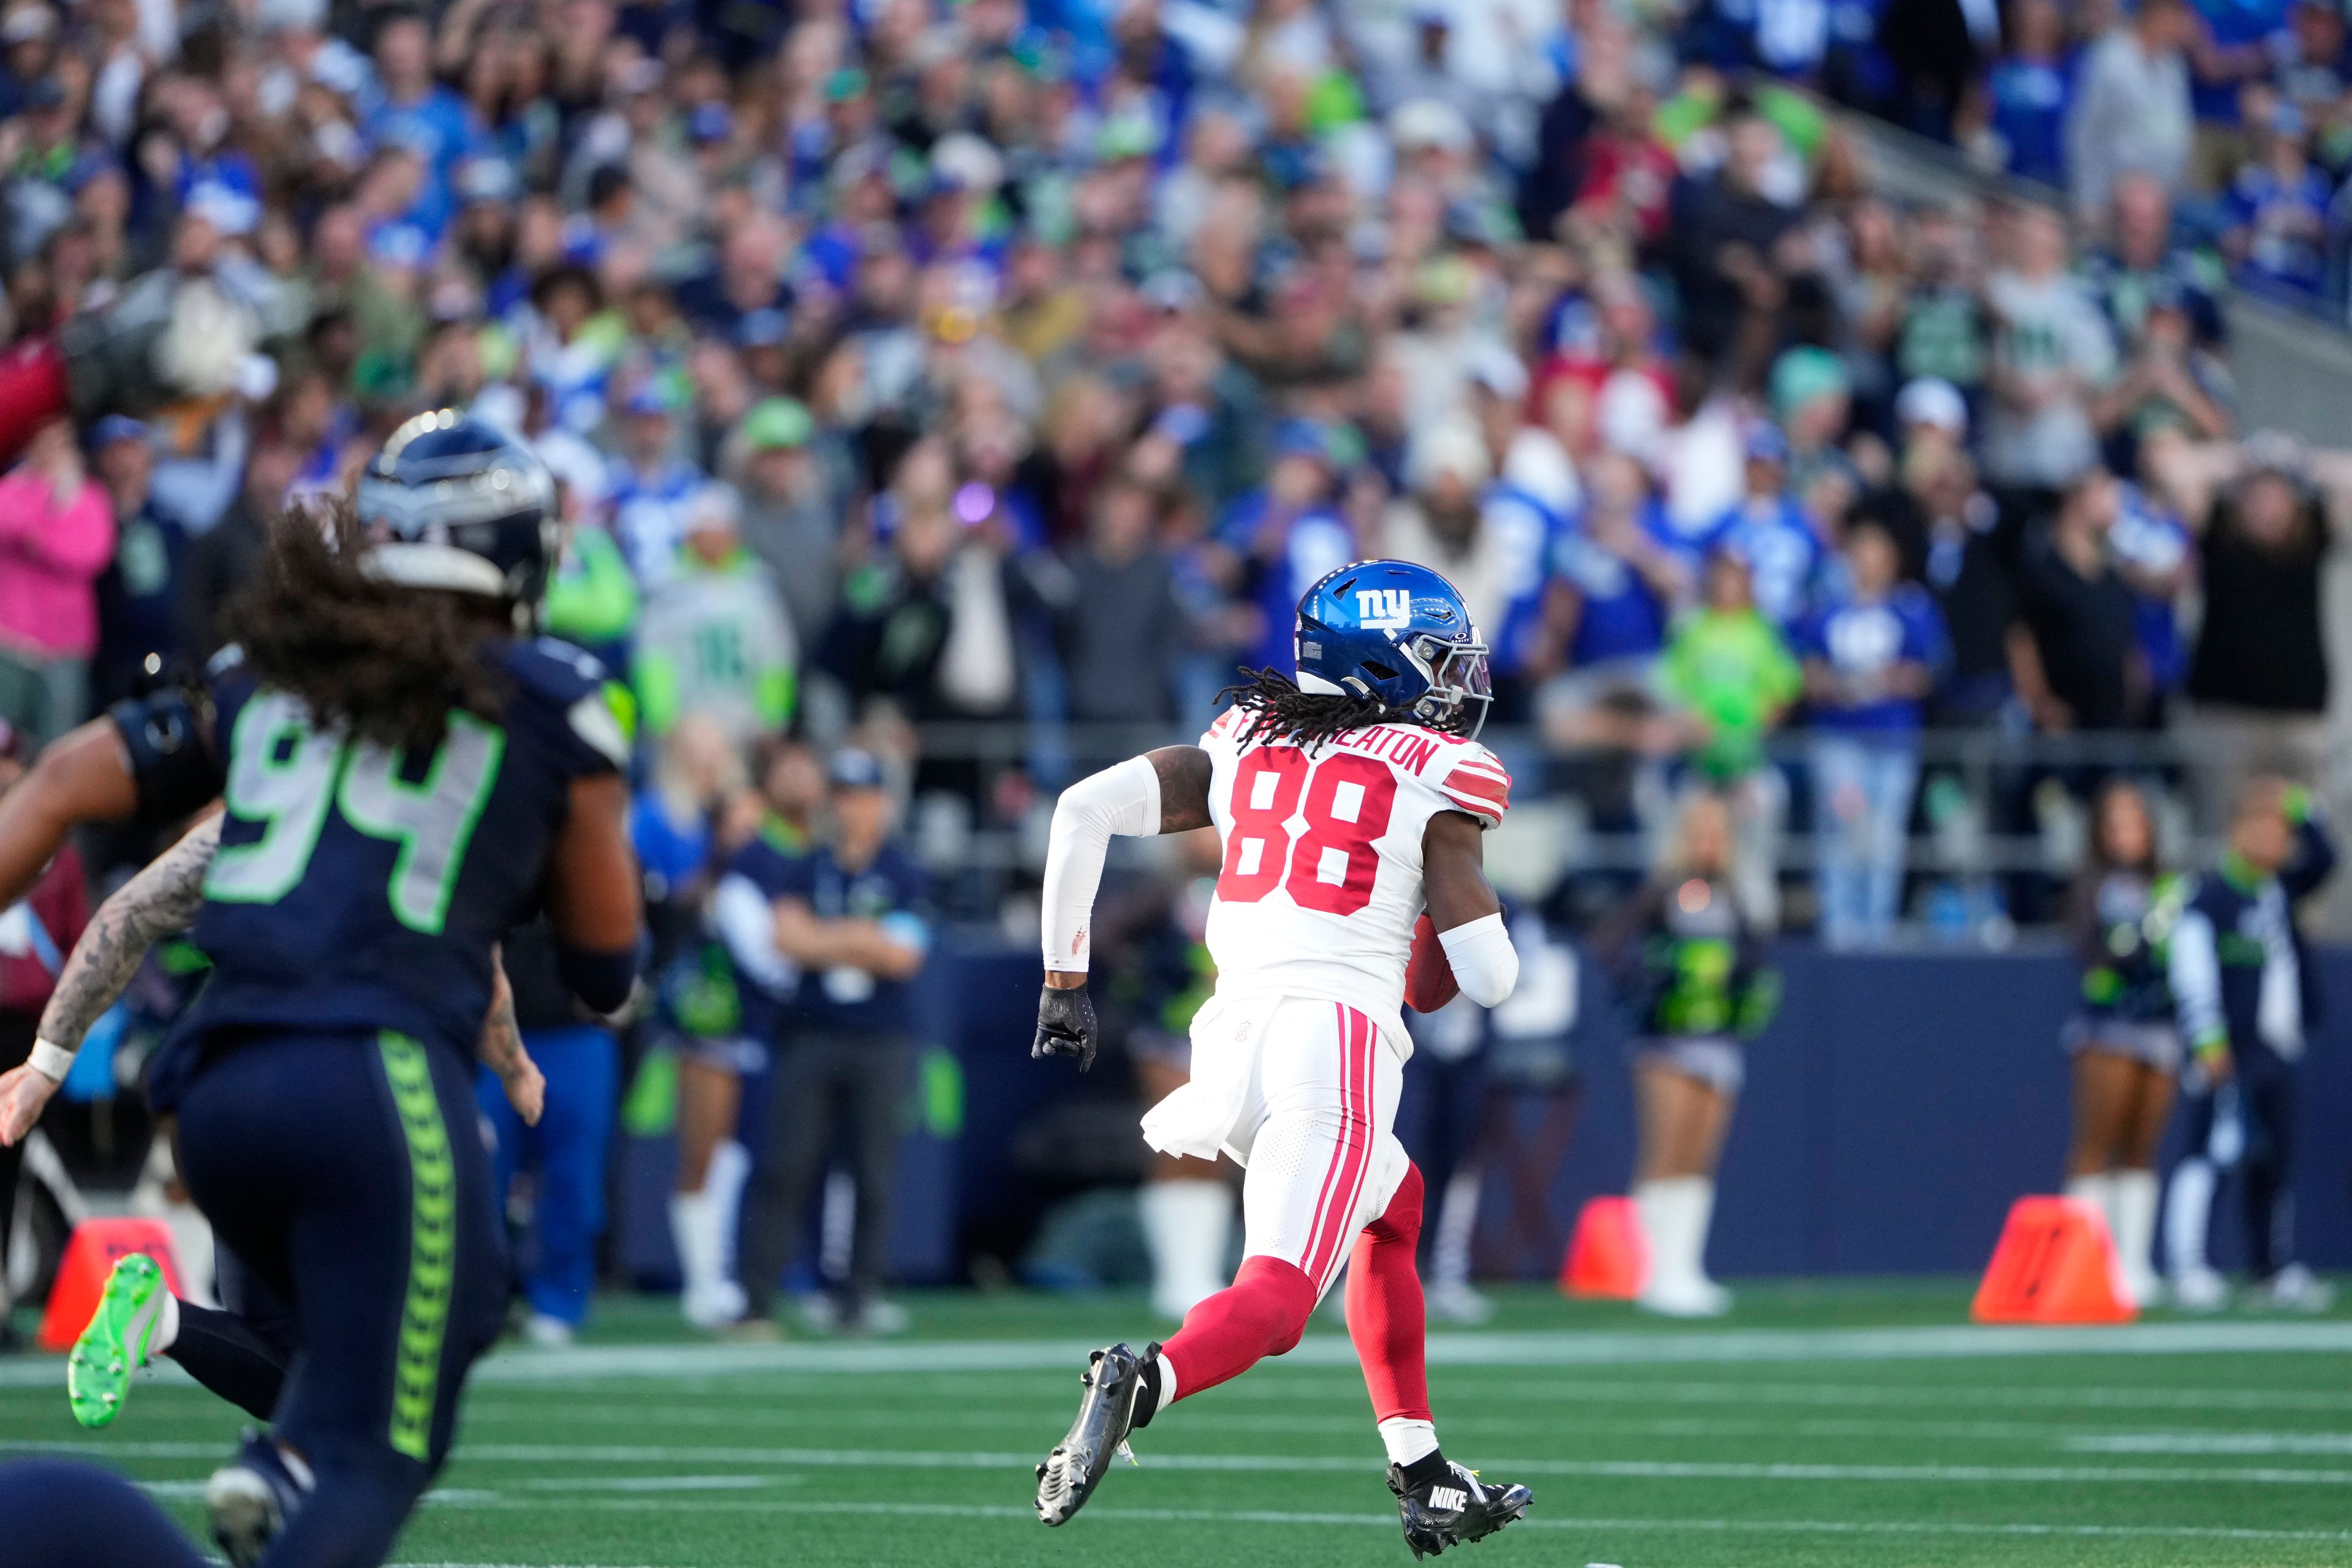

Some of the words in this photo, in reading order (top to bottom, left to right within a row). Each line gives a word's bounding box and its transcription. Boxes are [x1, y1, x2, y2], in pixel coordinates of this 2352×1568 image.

[1355, 589, 1410, 630] ny
[203, 687, 507, 936] 94
[1215, 745, 1398, 916] 88
[1428, 1486, 1468, 1512] NIKE
